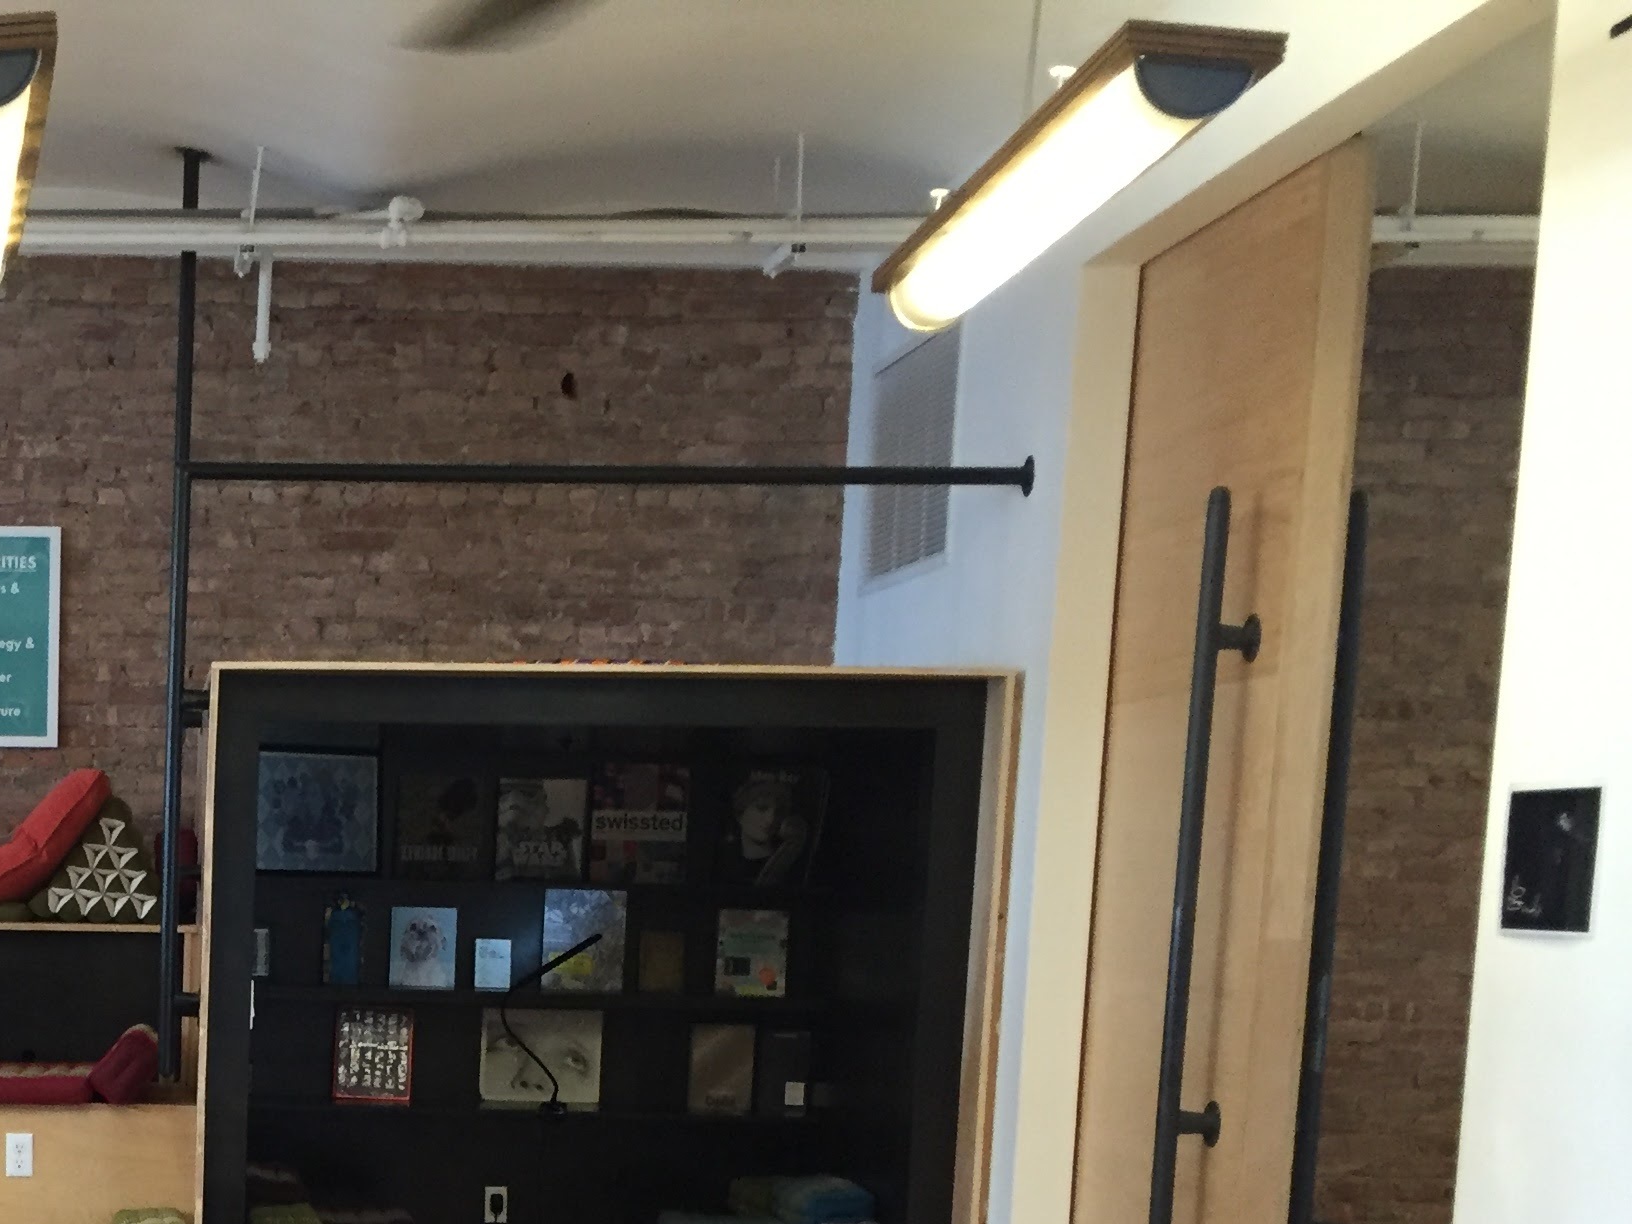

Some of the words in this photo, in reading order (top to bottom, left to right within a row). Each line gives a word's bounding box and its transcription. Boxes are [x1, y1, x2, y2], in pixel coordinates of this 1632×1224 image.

[11, 582, 19, 594] &
[26, 637, 34, 649] &
[596, 813, 683, 832] swissted
